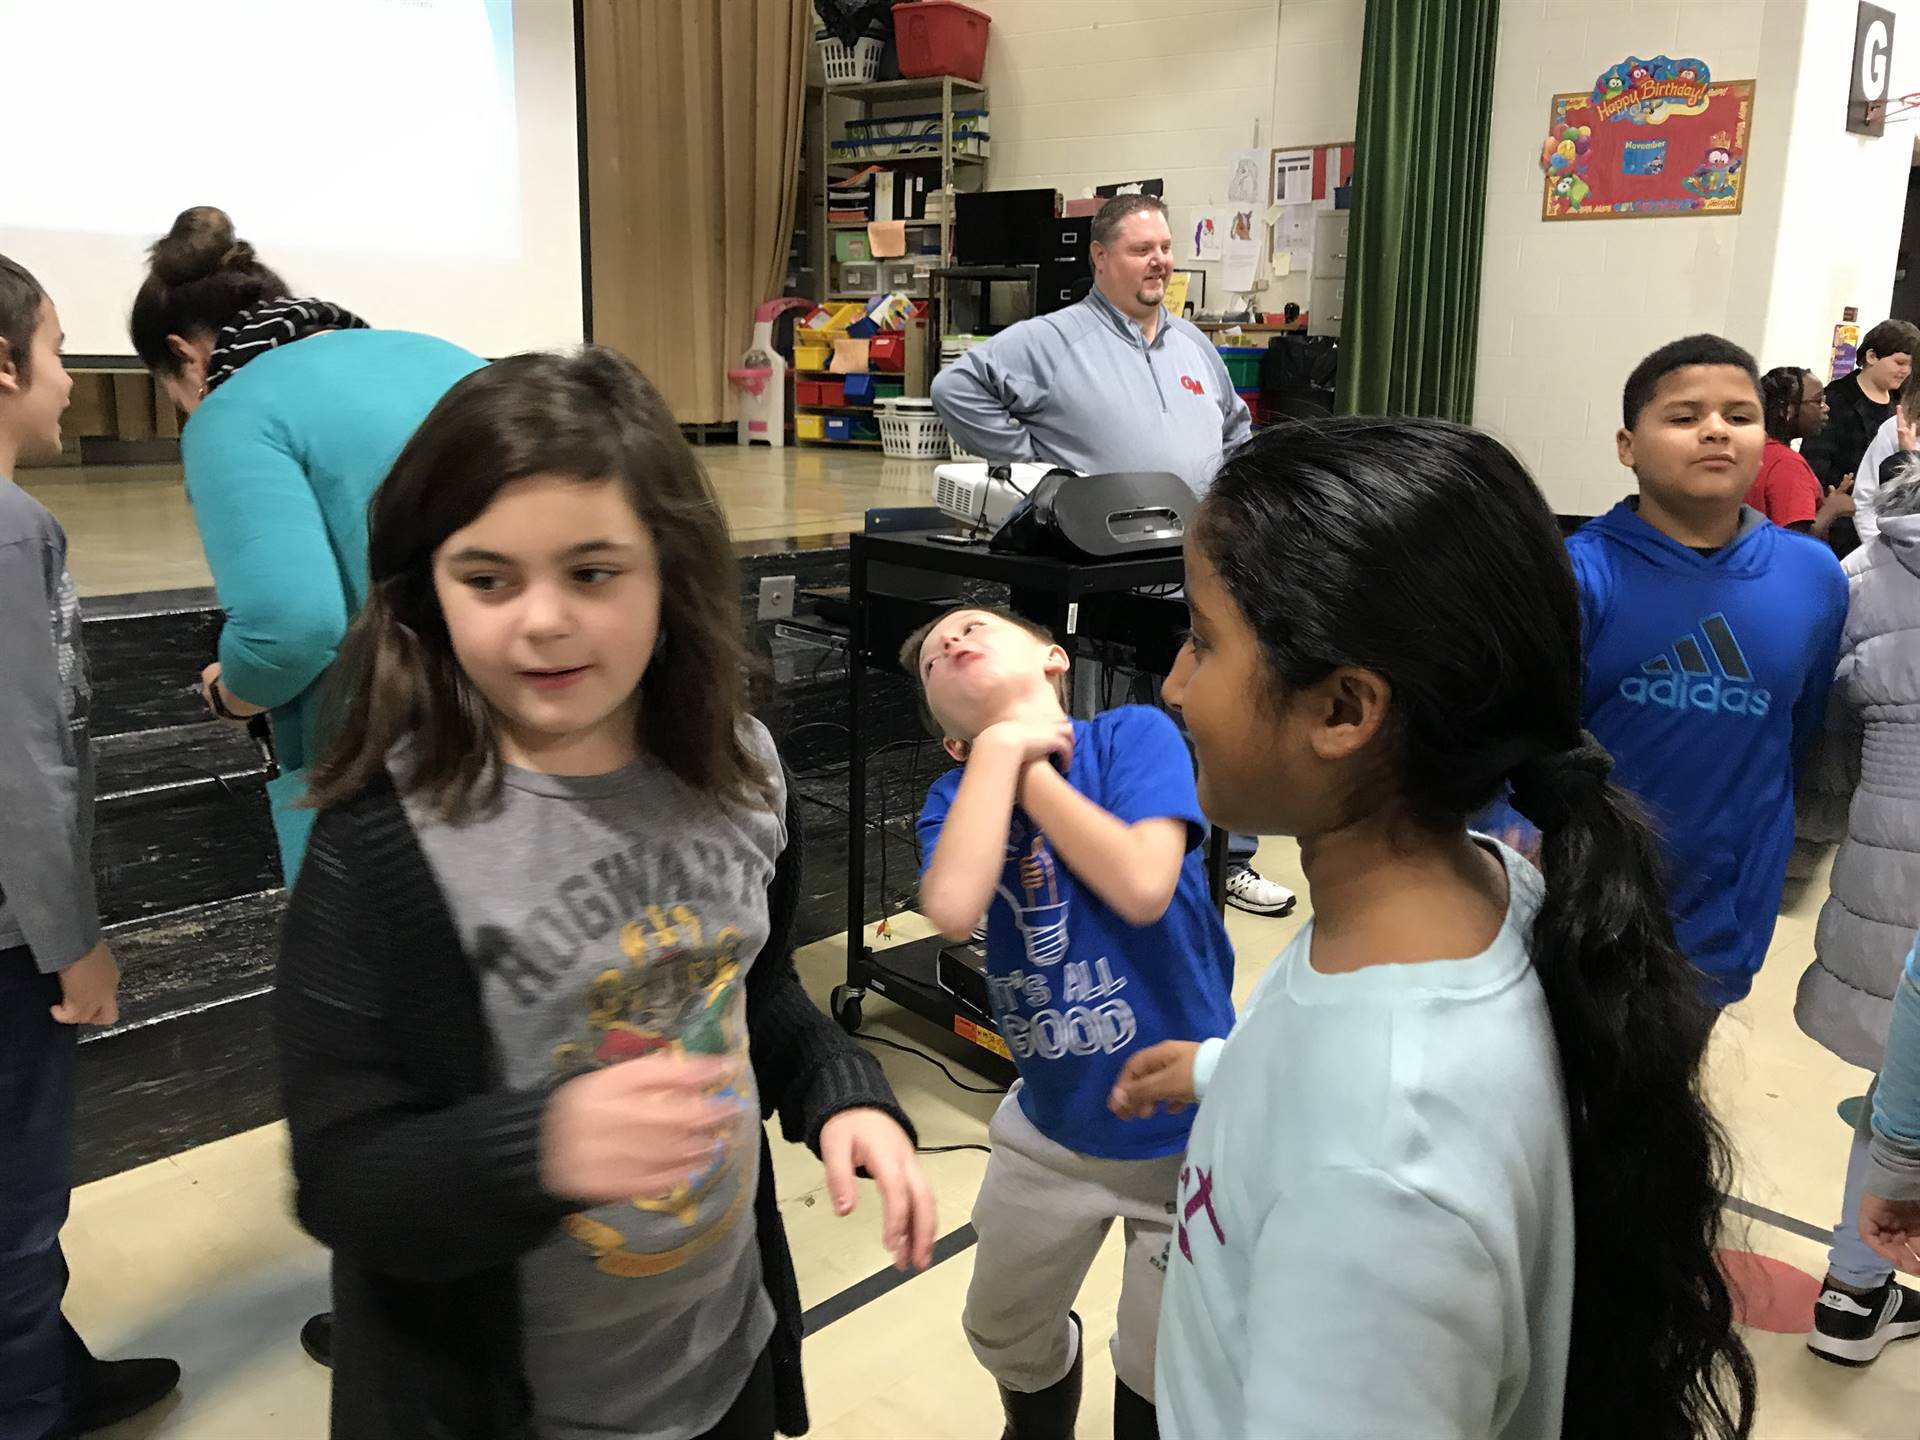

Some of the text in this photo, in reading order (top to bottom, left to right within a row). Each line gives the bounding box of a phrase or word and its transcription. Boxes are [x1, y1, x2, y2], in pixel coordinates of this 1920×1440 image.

[1862, 20, 1888, 101] G
[1597, 79, 1708, 121] Happy Birthday!
[1625, 141, 1666, 150] November
[1619, 671, 1772, 716] adidas
[1063, 956, 1128, 1003] ALL
[1002, 998, 1137, 1059] GOOD
